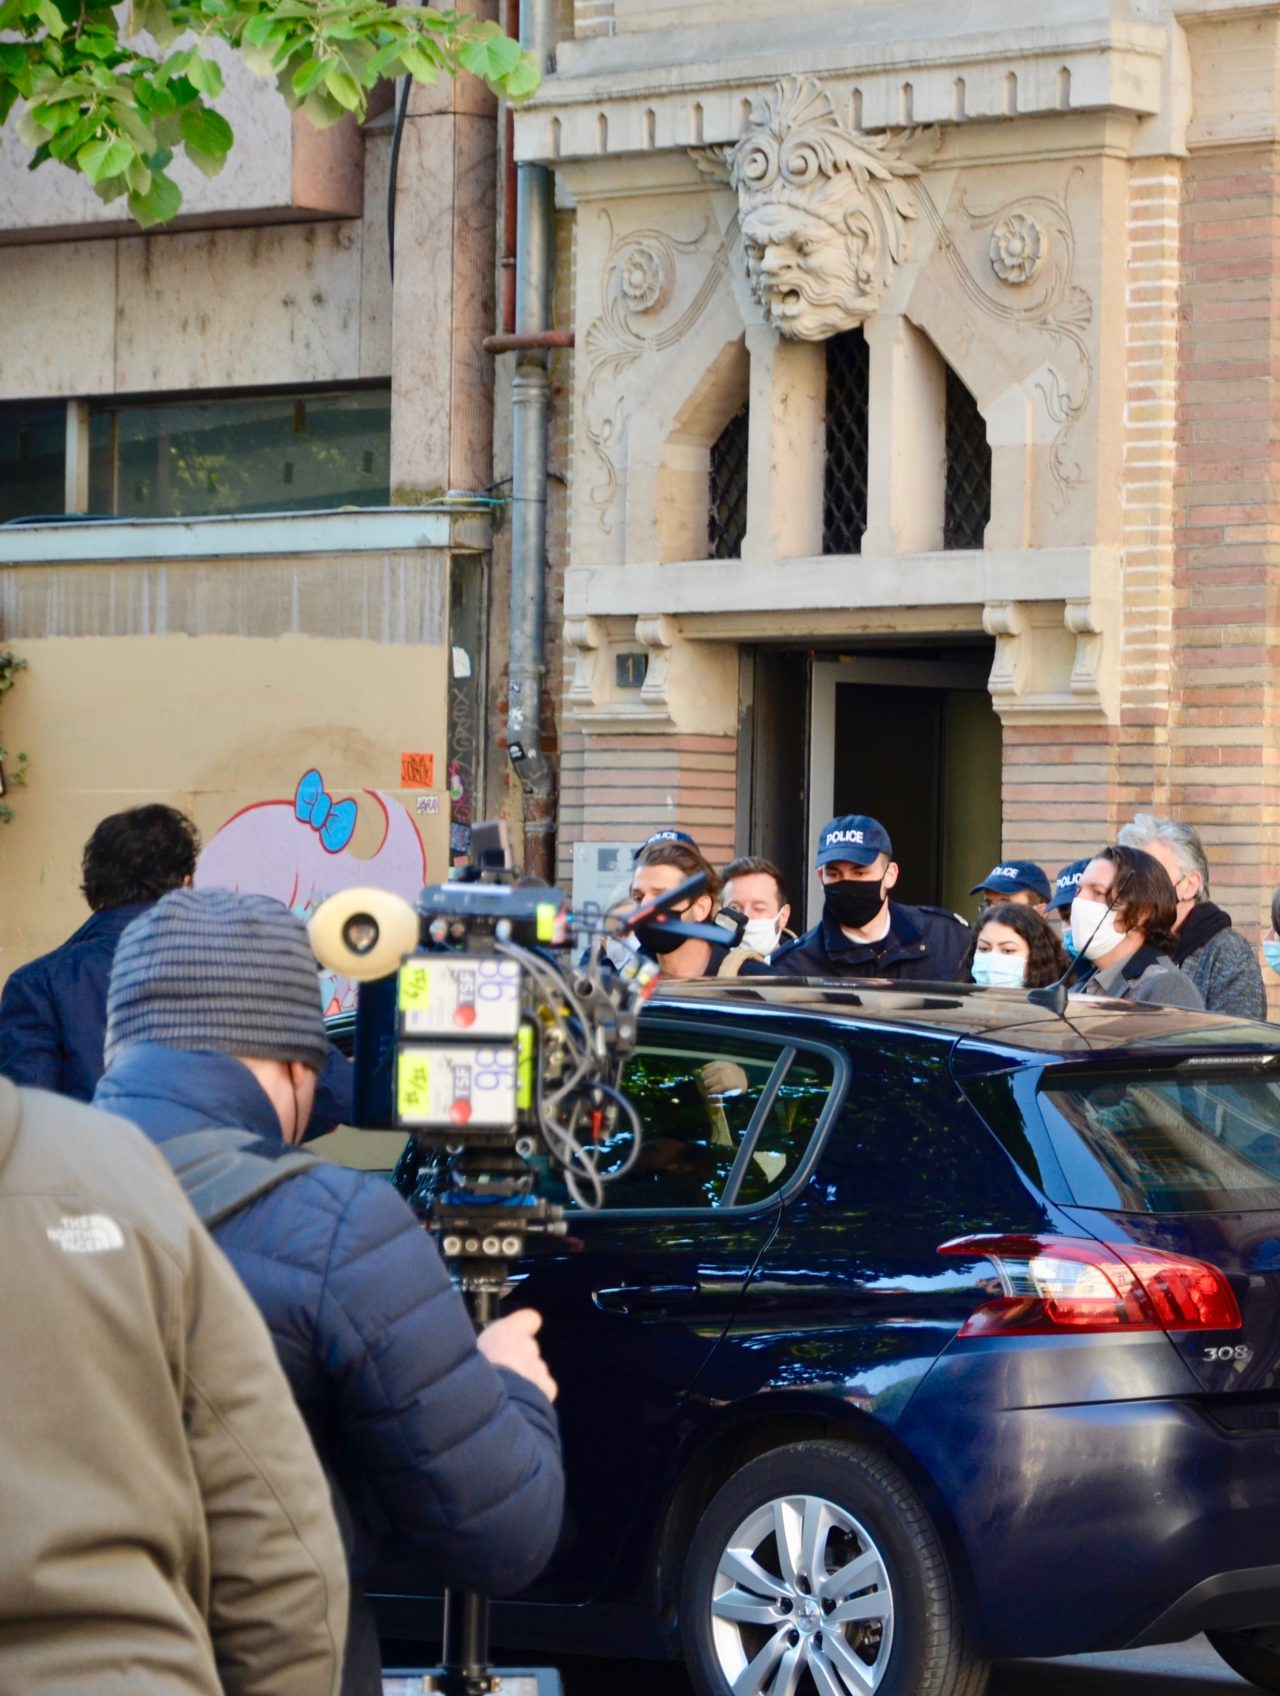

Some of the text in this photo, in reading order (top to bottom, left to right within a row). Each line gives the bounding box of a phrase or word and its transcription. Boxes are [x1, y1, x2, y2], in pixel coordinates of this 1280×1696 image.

[826, 829, 864, 846] POLICE
[990, 866, 1020, 880] OLICE
[1056, 872, 1083, 888] POLIC
[1203, 1345, 1248, 1362] 308
